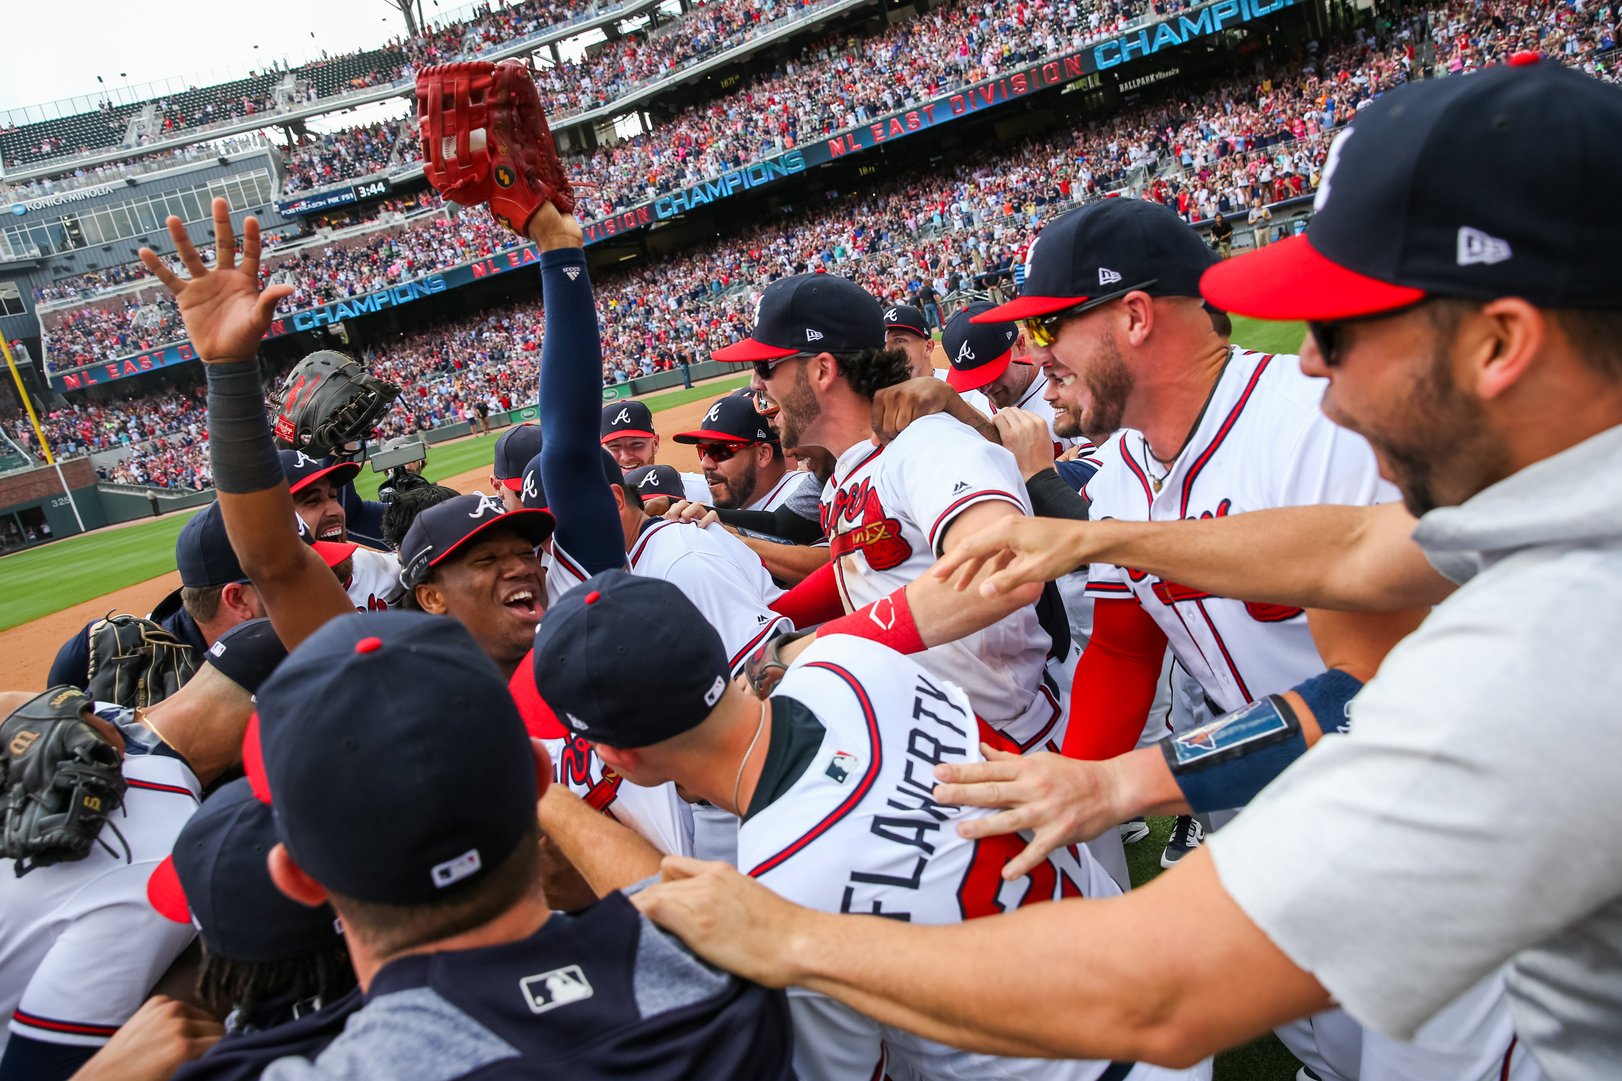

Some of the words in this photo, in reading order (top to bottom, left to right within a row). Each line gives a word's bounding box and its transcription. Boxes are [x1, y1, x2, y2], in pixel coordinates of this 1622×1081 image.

[1094, 0, 1296, 70] CHAMPIO
[1119, 73, 1156, 93] BALLPARK
[828, 133, 862, 158] NL
[870, 104, 936, 144] EAST
[950, 54, 1085, 115] DIVISION
[358, 182, 386, 198] 3:44
[654, 150, 806, 220] CHAMPIONS
[26, 195, 67, 212] KONICA
[69, 185, 114, 203] MINOLTA
[471, 259, 502, 279] NL
[293, 275, 448, 331] CHAMPIONS
[955, 339, 976, 364] A
[63, 371, 98, 391] NL
[105, 351, 166, 379] EAST
[611, 407, 631, 426] A
[702, 402, 723, 423] A
[520, 469, 538, 502] A
[638, 469, 660, 489] A
[51, 496, 70, 508] 325
[468, 490, 505, 518] A
